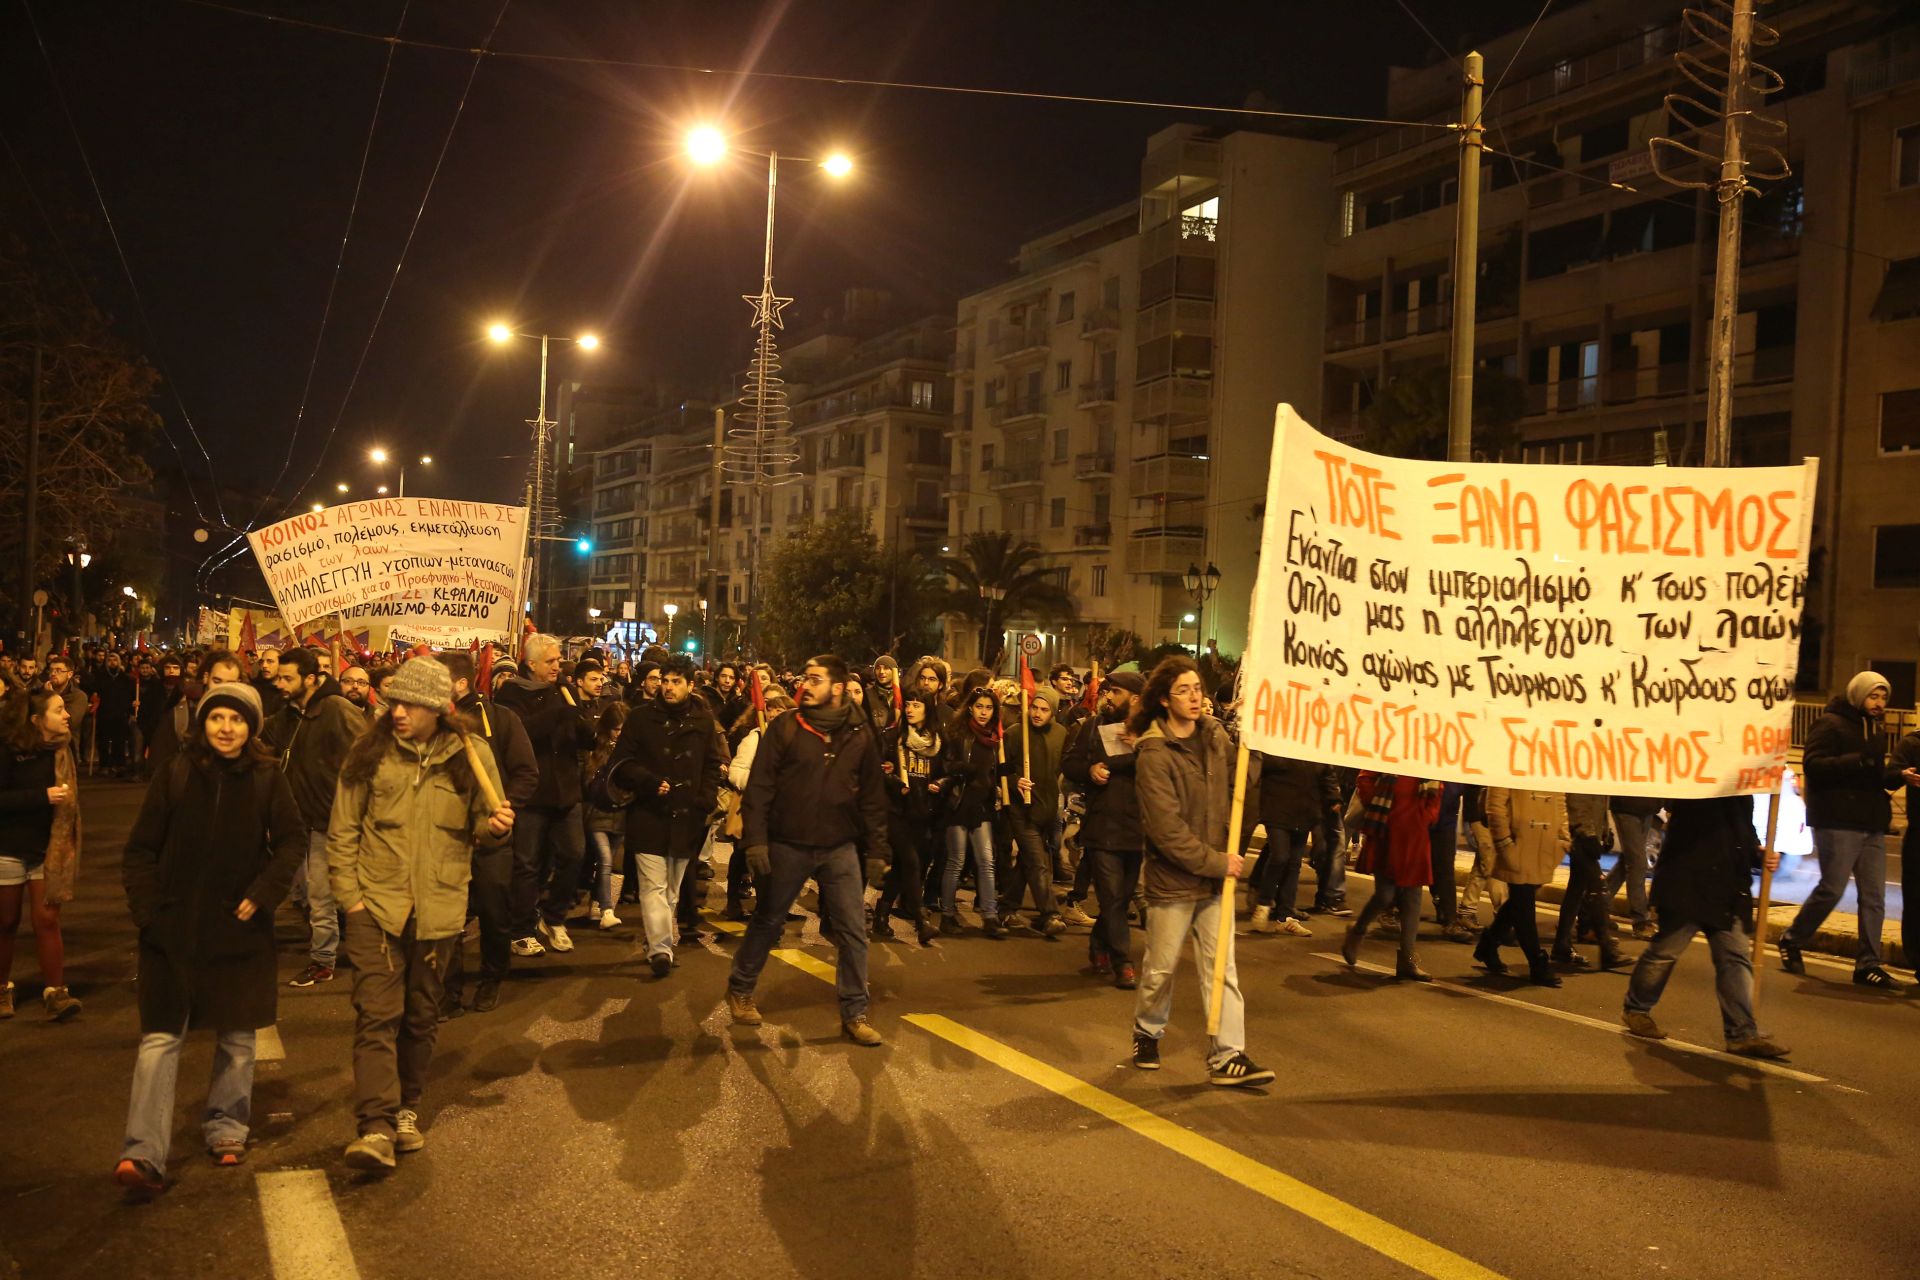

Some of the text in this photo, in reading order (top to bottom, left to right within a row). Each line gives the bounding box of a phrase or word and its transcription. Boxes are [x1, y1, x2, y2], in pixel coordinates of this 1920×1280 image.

[260, 510, 329, 551] ΚΟΙΝΟΣ
[418, 499, 489, 520] ΕΝΑΝΤΙΑ
[495, 505, 517, 524] ΣΕ
[411, 520, 501, 540] εκμετάλλευση
[1314, 450, 1798, 558] ΠΟΤΕ ΞΑΝΑ ΦΑΣΙΣΜΟΣ
[271, 542, 389, 588] ΦΙΛΙΑ των λαών
[279, 561, 372, 606] ΑΛΛΗΛΕΓΓΥΗ
[1370, 558, 1409, 593] στον
[1430, 557, 1591, 612] ιμπεριαλισμό
[434, 587, 499, 605] ΚΕΦΑΛΑΙΟ
[1284, 566, 1341, 621] Όπλο
[1367, 601, 1404, 635] μας
[1423, 609, 1442, 635] η
[1456, 606, 1613, 658] αλληλεγγύη
[1025, 640, 1038, 650] 60
[1284, 620, 1348, 676] Κοινός
[1363, 649, 1439, 691] αγώνας
[1447, 664, 1474, 698] με
[1478, 655, 1587, 707] Τούρκους
[1631, 654, 1736, 716] Κούρδους
[1253, 678, 1482, 774] ΑΝΤΙΦΑΣΙΣΤΙΚΟΣ
[1501, 718, 1717, 784] ΣΥΝΤΟΝΙΣΜΟΣ
